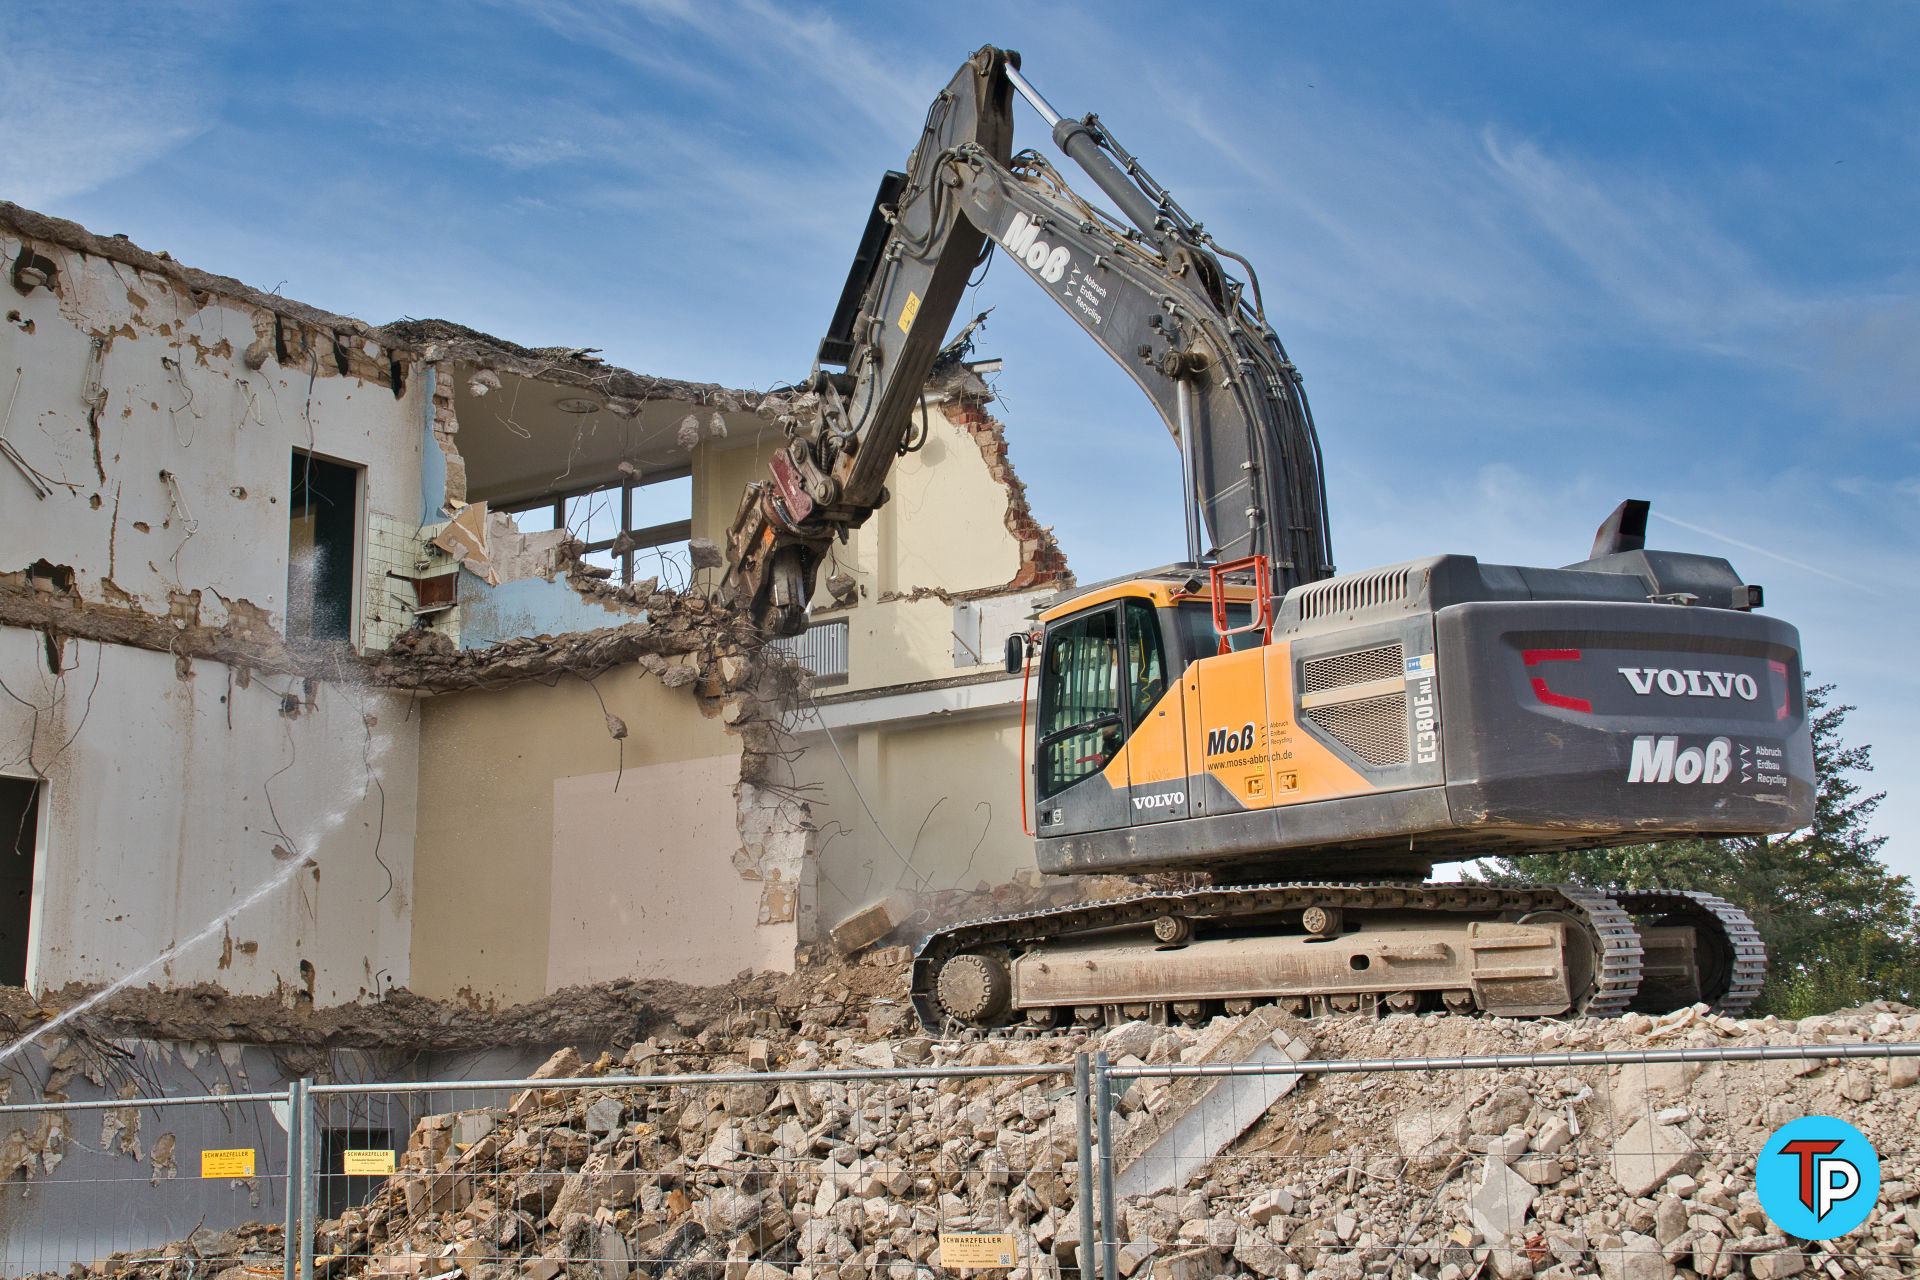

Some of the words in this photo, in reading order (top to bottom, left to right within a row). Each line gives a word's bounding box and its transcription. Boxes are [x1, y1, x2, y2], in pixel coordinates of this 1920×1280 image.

[1002, 211, 1071, 284] Moß
[1079, 285, 1100, 306] Erdbau
[1083, 274, 1107, 298] Abbruch
[1075, 296, 1102, 324] Recycling
[1617, 667, 1758, 701] VOLVO
[1269, 721, 1289, 729] Abbruch
[1207, 721, 1256, 757] Moß
[1271, 737, 1293, 745] Recycling
[1207, 749, 1293, 771] www.moss-abbruch.de
[1627, 735, 1732, 784] Moß
[1755, 745, 1782, 757] Abbruch
[1756, 759, 1780, 771] Erdbau
[1757, 772, 1787, 786] Recycling
[1132, 791, 1185, 810] VOLVO
[204, 1151, 249, 1159] SCHWARZFELLER
